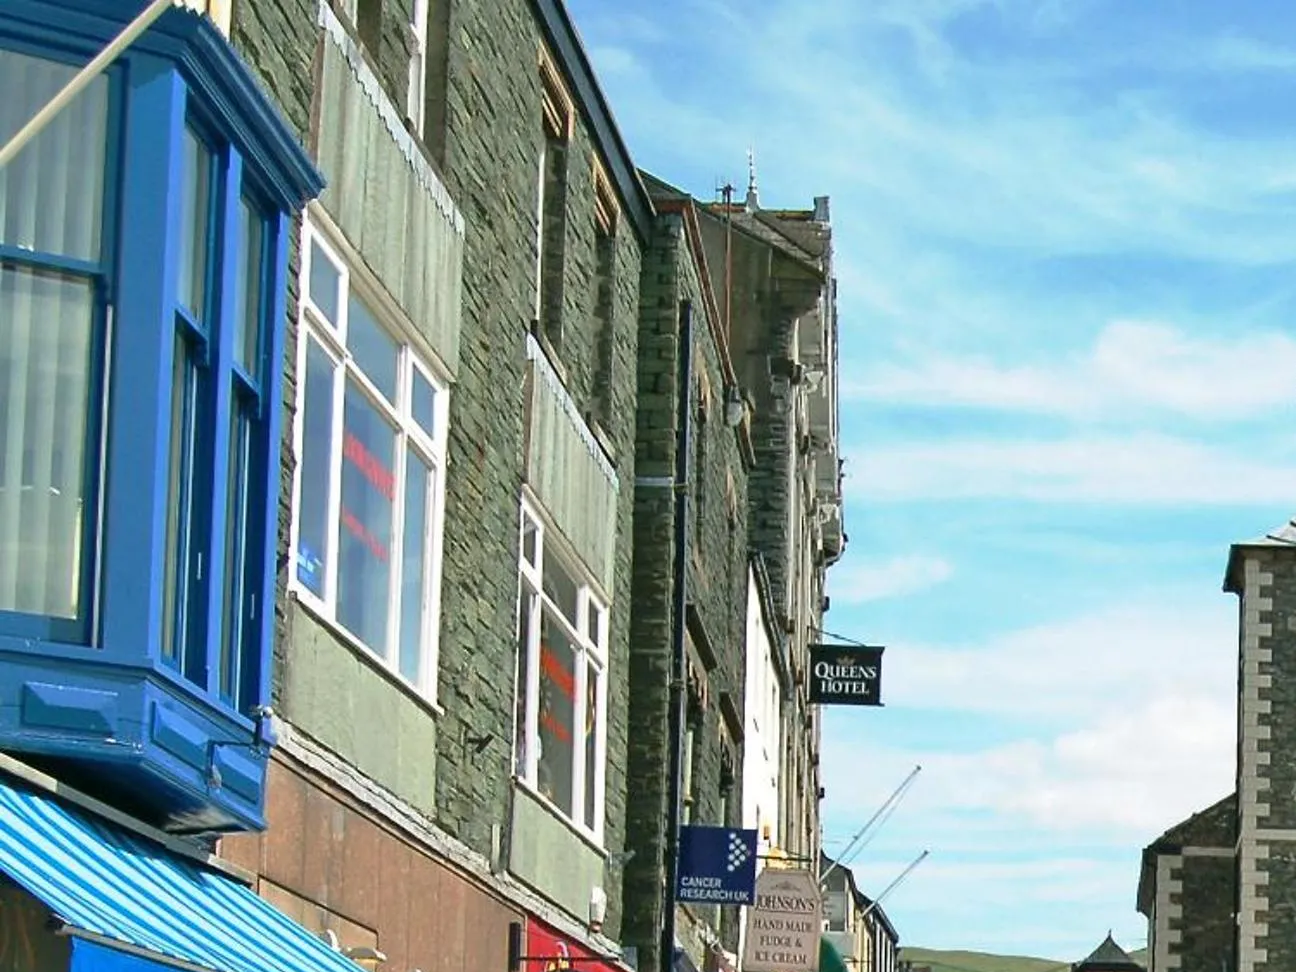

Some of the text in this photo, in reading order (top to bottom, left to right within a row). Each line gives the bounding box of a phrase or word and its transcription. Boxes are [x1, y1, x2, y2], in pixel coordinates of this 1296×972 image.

[815, 661, 877, 680] QUEENS
[820, 681, 870, 695] HOTEL
[680, 876, 722, 888] CANCER
[680, 888, 749, 901] RESEARCH UK
[753, 919, 813, 933] HAND MADE
[760, 936, 803, 948] FUDGE &
[755, 951, 807, 964] ICE CREAM
